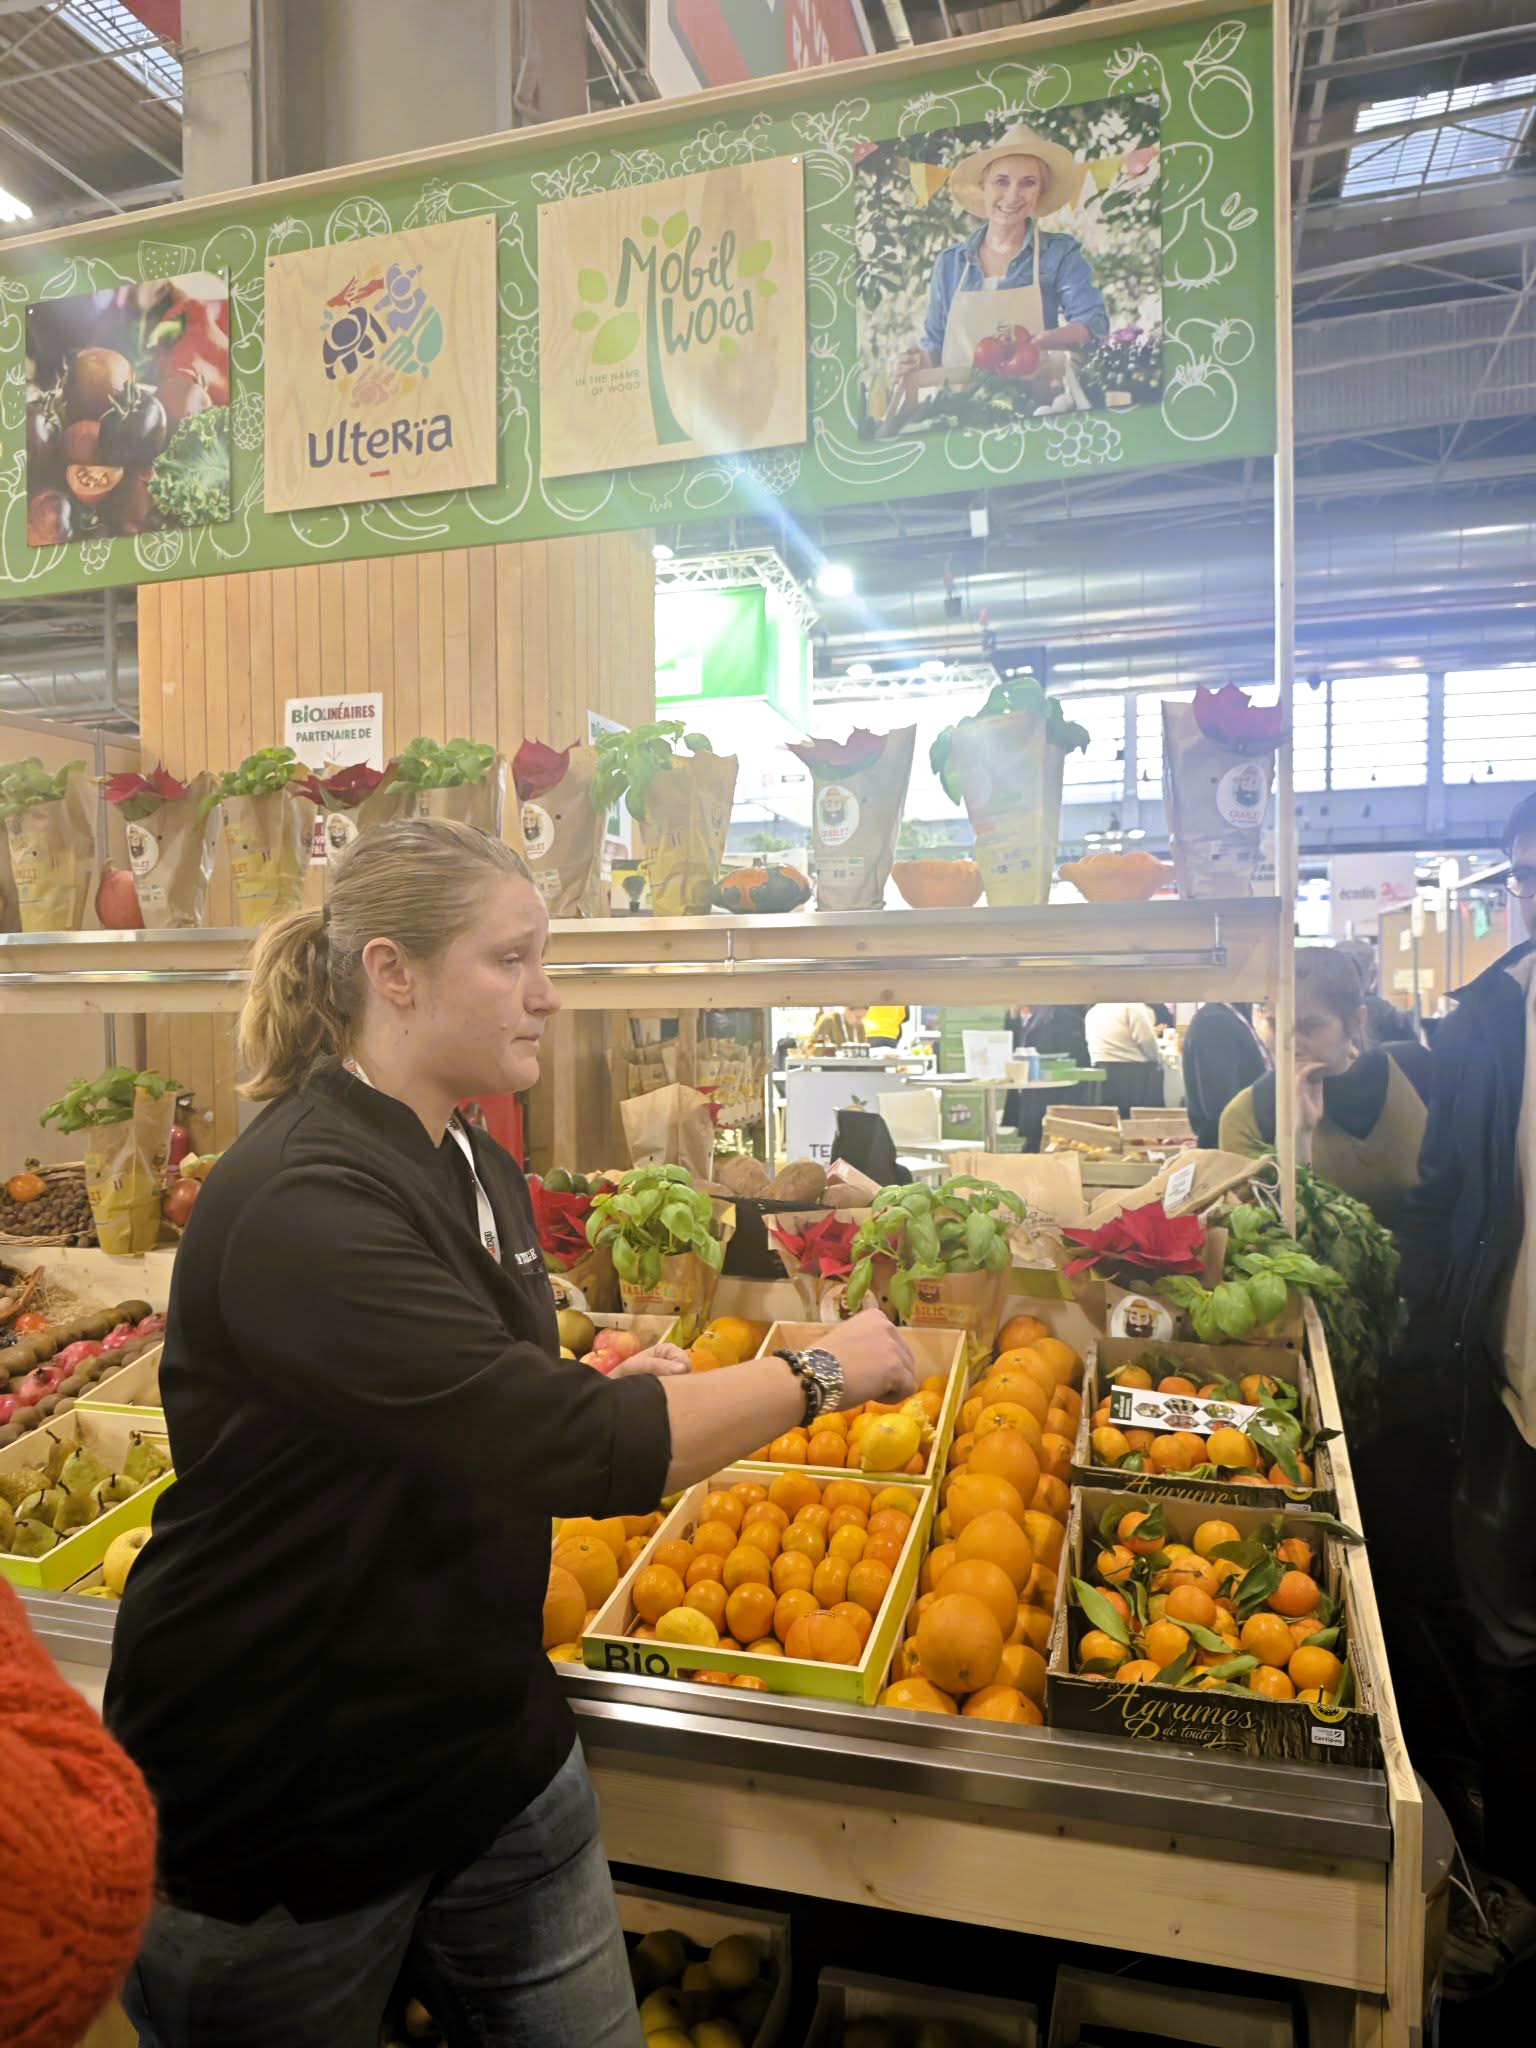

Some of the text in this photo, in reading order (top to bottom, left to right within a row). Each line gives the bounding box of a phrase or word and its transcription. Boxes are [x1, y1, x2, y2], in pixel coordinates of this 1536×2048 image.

[590, 373, 608, 384] THE
[609, 368, 640, 381] NAME
[608, 381, 640, 393] WOOD
[296, 728, 372, 743] PARTENAIRE DE
[604, 1643, 670, 1677] Bio
[1090, 1681, 1257, 1738] Agrumes
